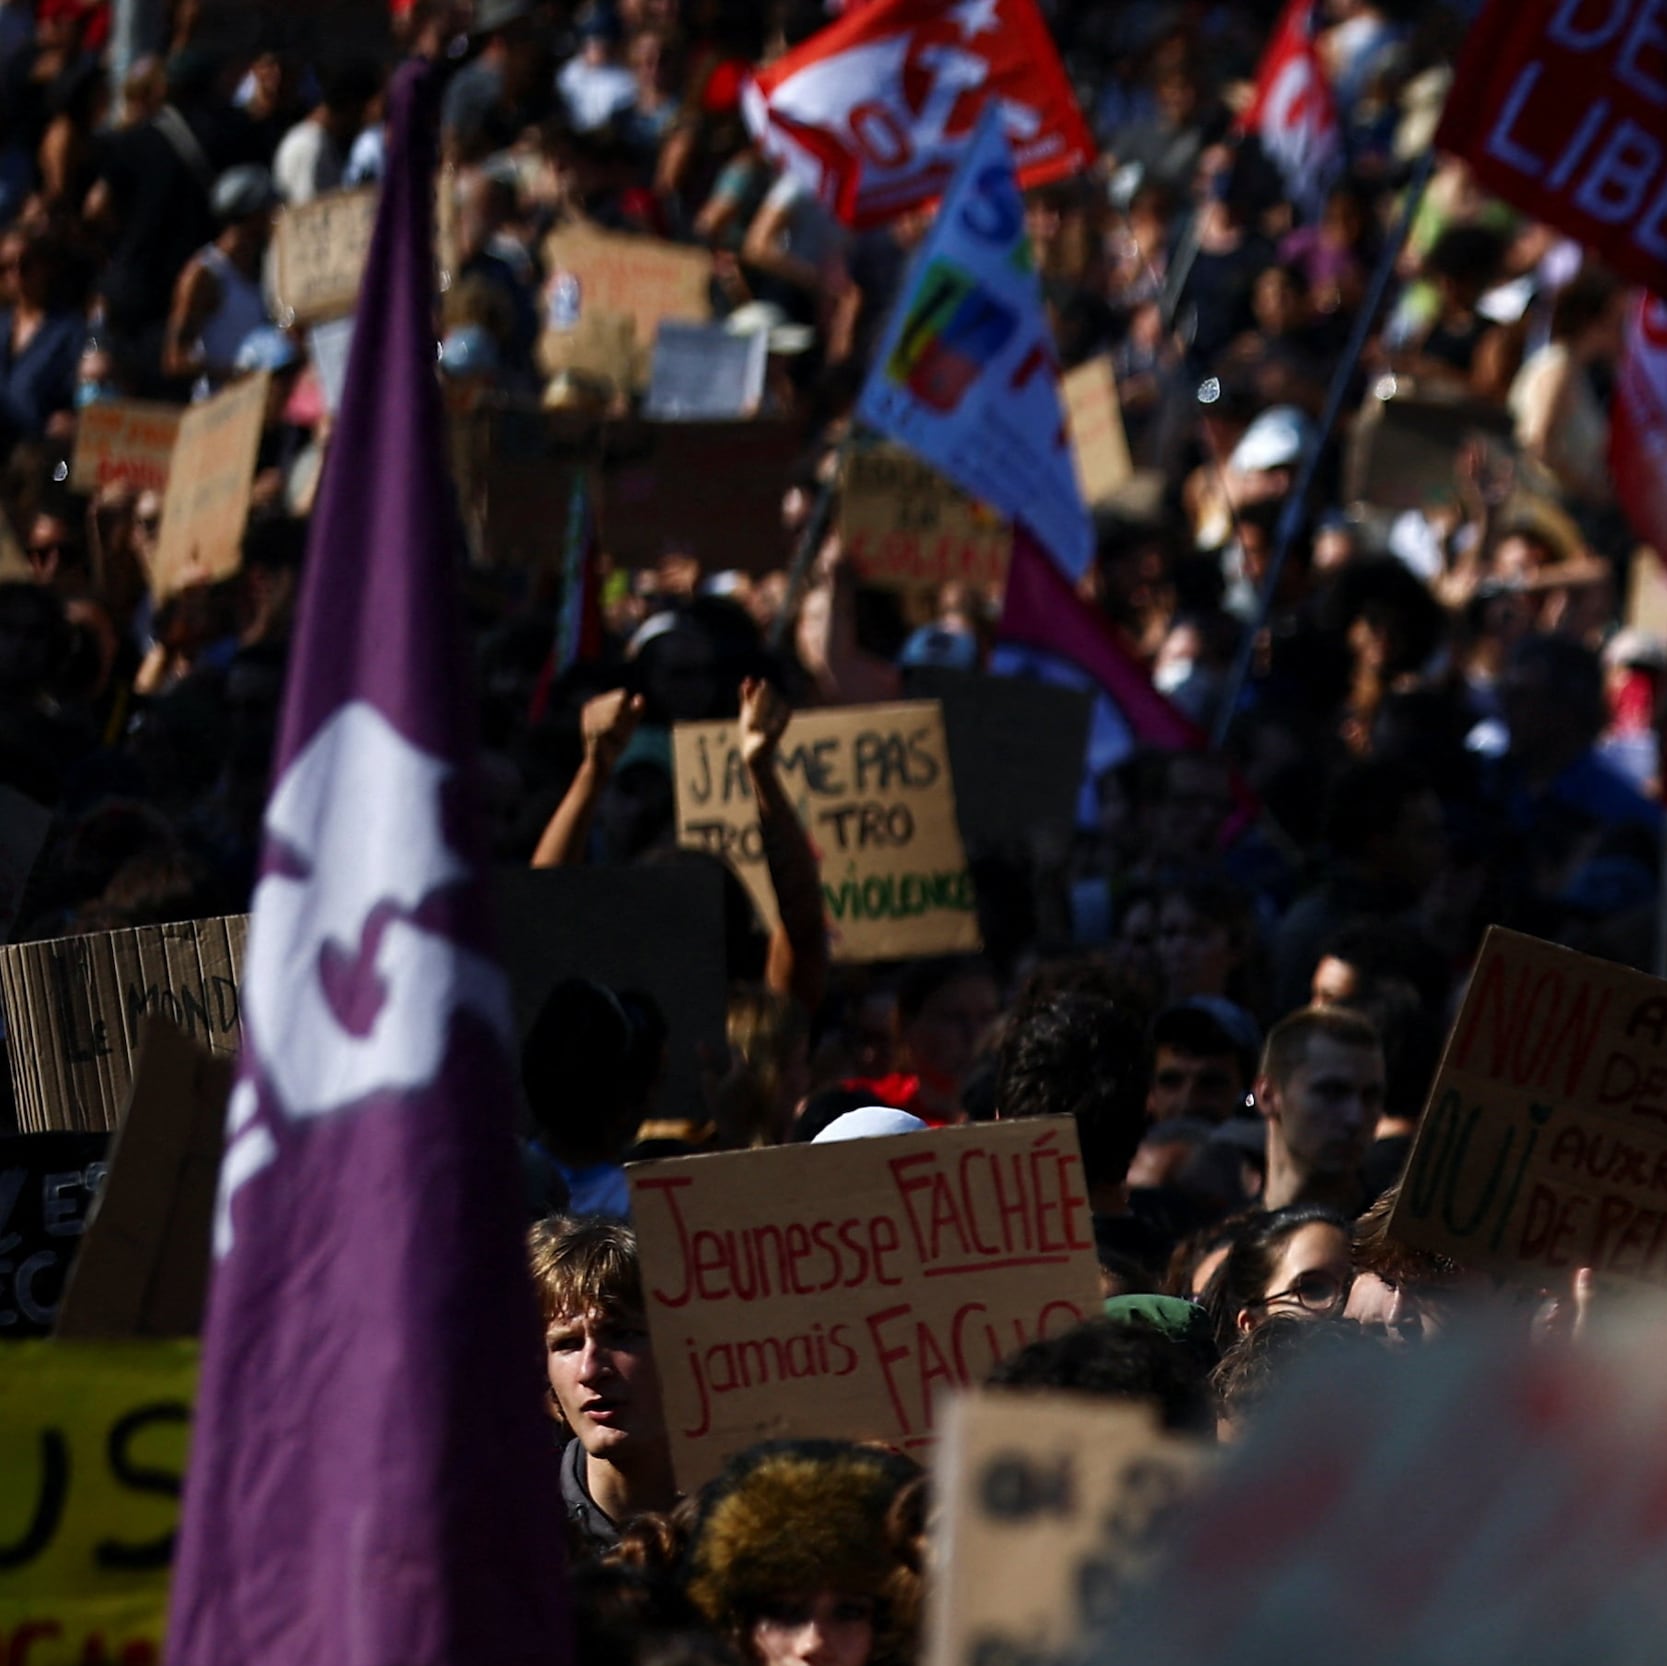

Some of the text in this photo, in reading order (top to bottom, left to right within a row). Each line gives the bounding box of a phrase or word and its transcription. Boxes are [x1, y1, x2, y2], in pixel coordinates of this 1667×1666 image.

[690, 727, 940, 805] J'AME PAS
[820, 805, 916, 849] TRO
[1456, 952, 1613, 1097] NON
[636, 1129, 1092, 1308] Jeunesse FACHÉE
[1516, 1183, 1596, 1266] DE
[683, 1322, 858, 1438] jamais
